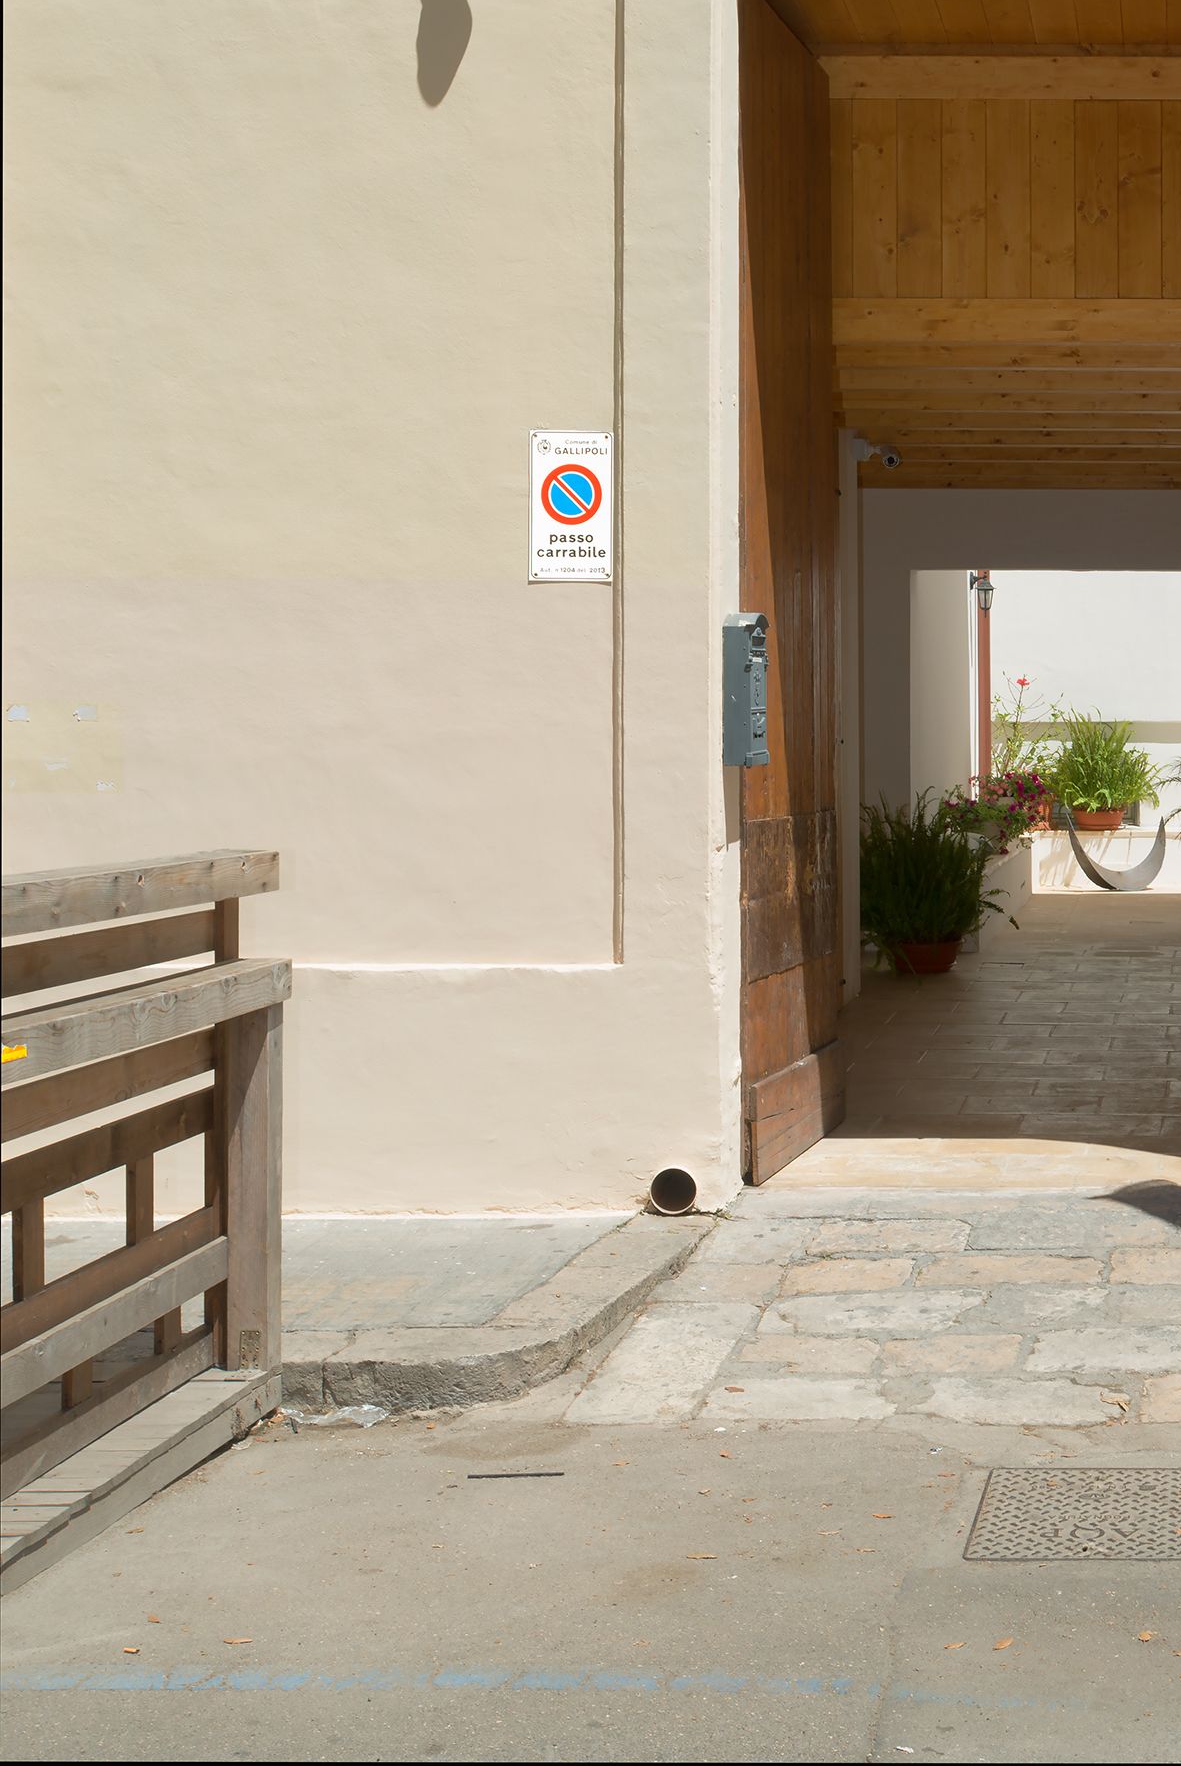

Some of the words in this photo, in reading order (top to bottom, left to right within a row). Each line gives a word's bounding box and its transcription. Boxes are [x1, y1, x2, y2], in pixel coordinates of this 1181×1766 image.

[554, 447, 608, 455] GALLIPOLI
[549, 534, 594, 544] passo
[537, 546, 606, 558] carrabile
[1039, 1523, 1140, 1539] AQP
